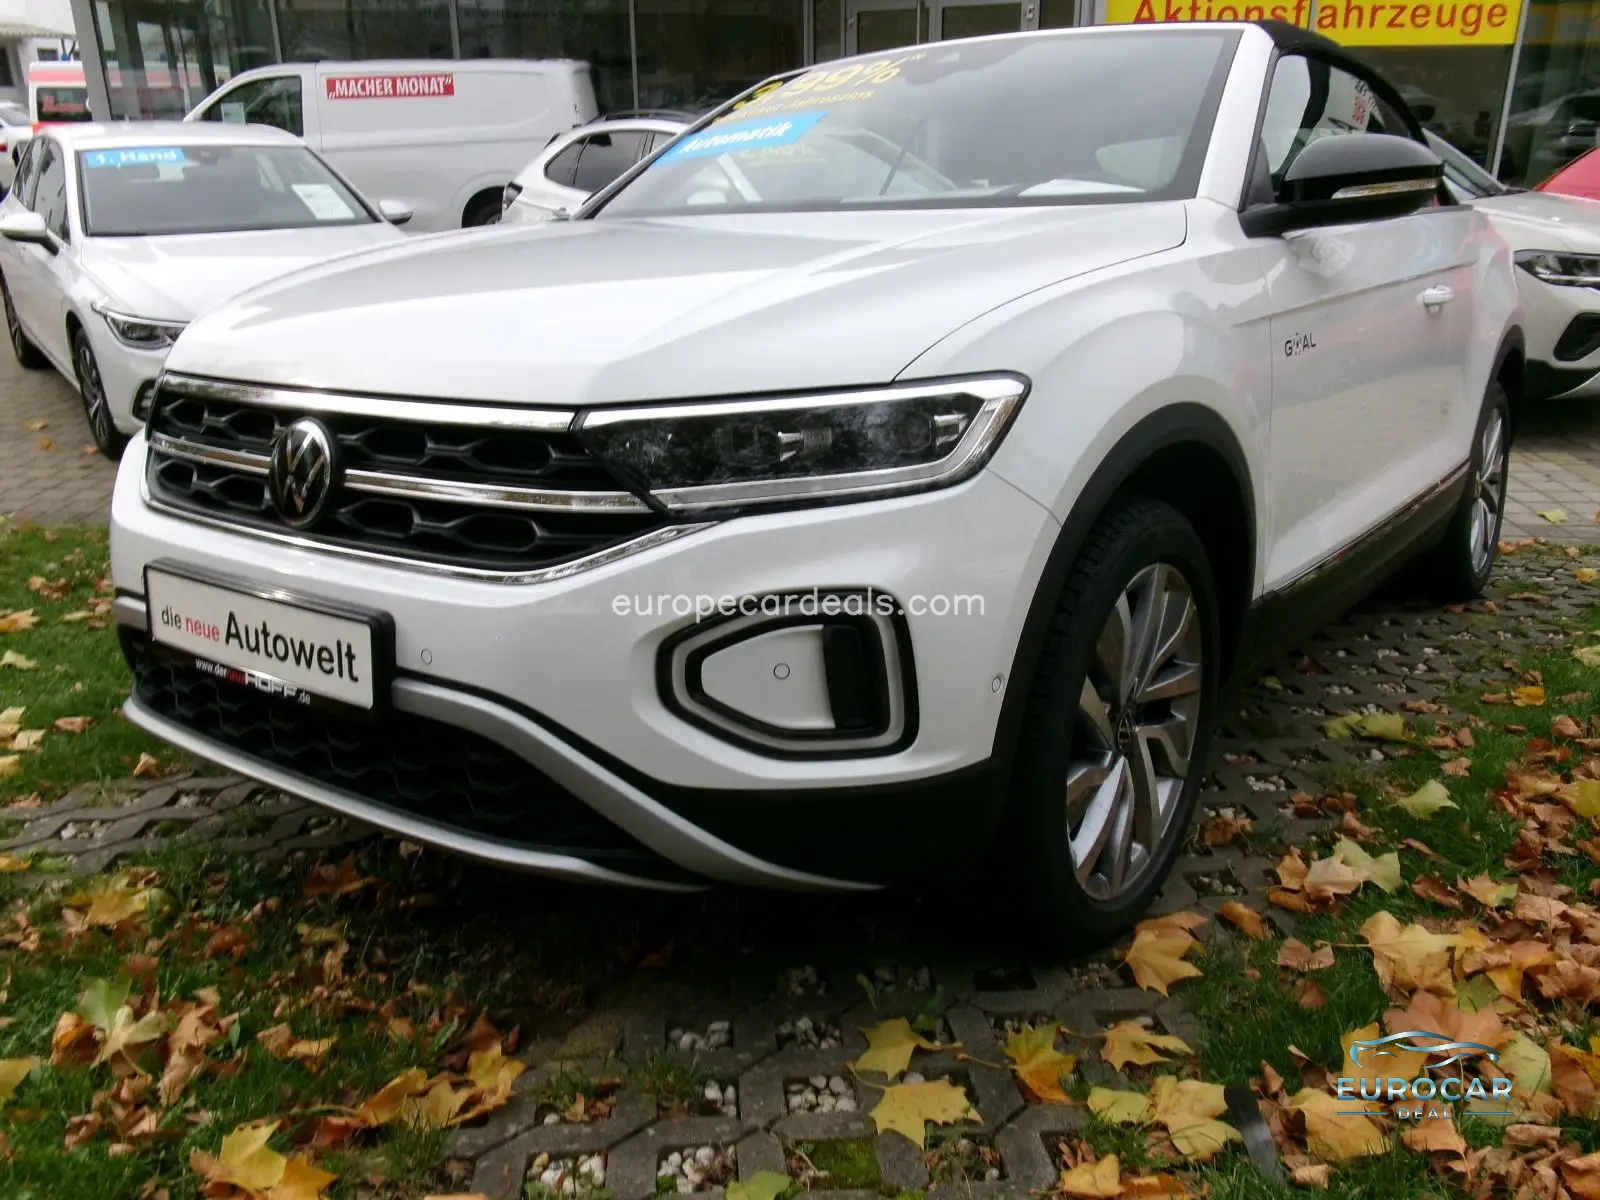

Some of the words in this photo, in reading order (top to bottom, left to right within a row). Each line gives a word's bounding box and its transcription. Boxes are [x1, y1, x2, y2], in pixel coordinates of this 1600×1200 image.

[678, 120, 793, 154] Automatik
[120, 149, 178, 162] Hand
[161, 606, 182, 630] die
[185, 616, 220, 642] neue
[225, 610, 359, 682] Autowelt
